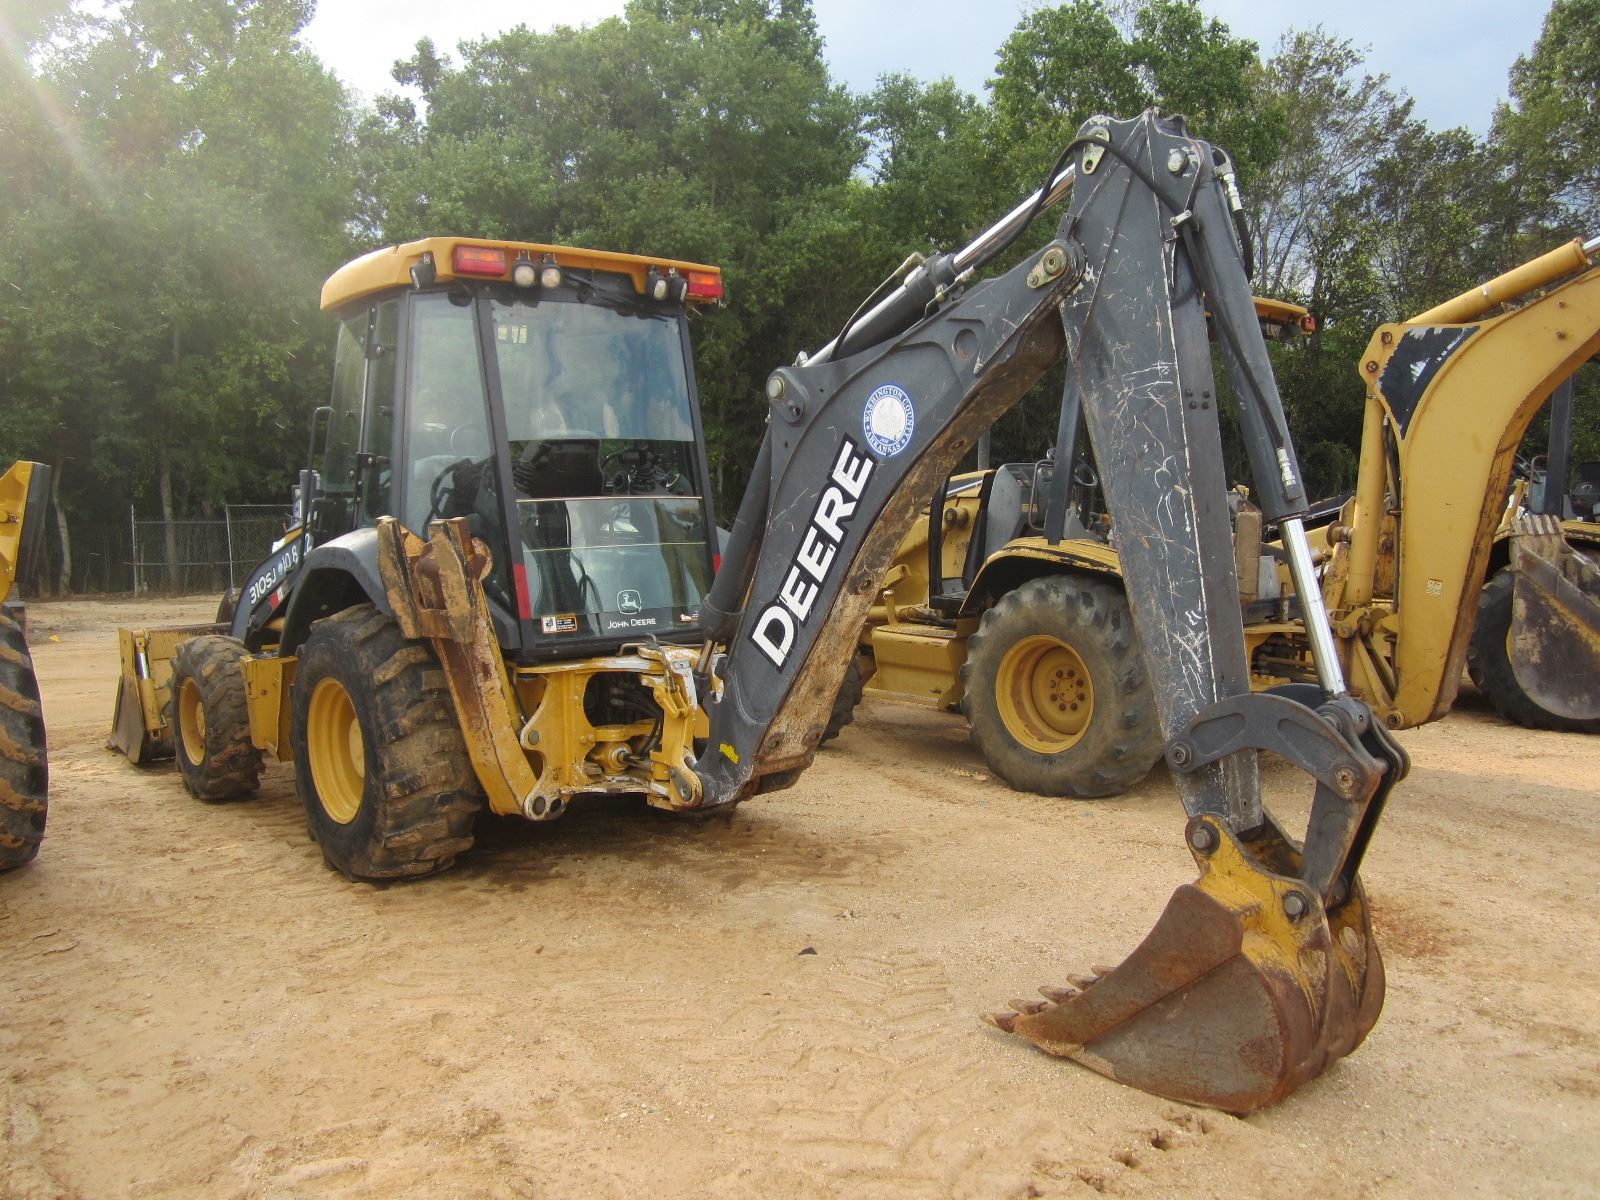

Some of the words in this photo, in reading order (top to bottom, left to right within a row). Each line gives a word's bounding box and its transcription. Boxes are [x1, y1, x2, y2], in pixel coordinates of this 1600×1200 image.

[865, 388, 903, 422] WASHINGTON
[903, 398, 913, 439] COUNTY
[866, 432, 901, 453] ARKANSAS
[752, 440, 874, 667] DEERE
[249, 567, 277, 605] 310SJ
[607, 620, 629, 629] JOHN
[630, 618, 657, 627] DEERE
